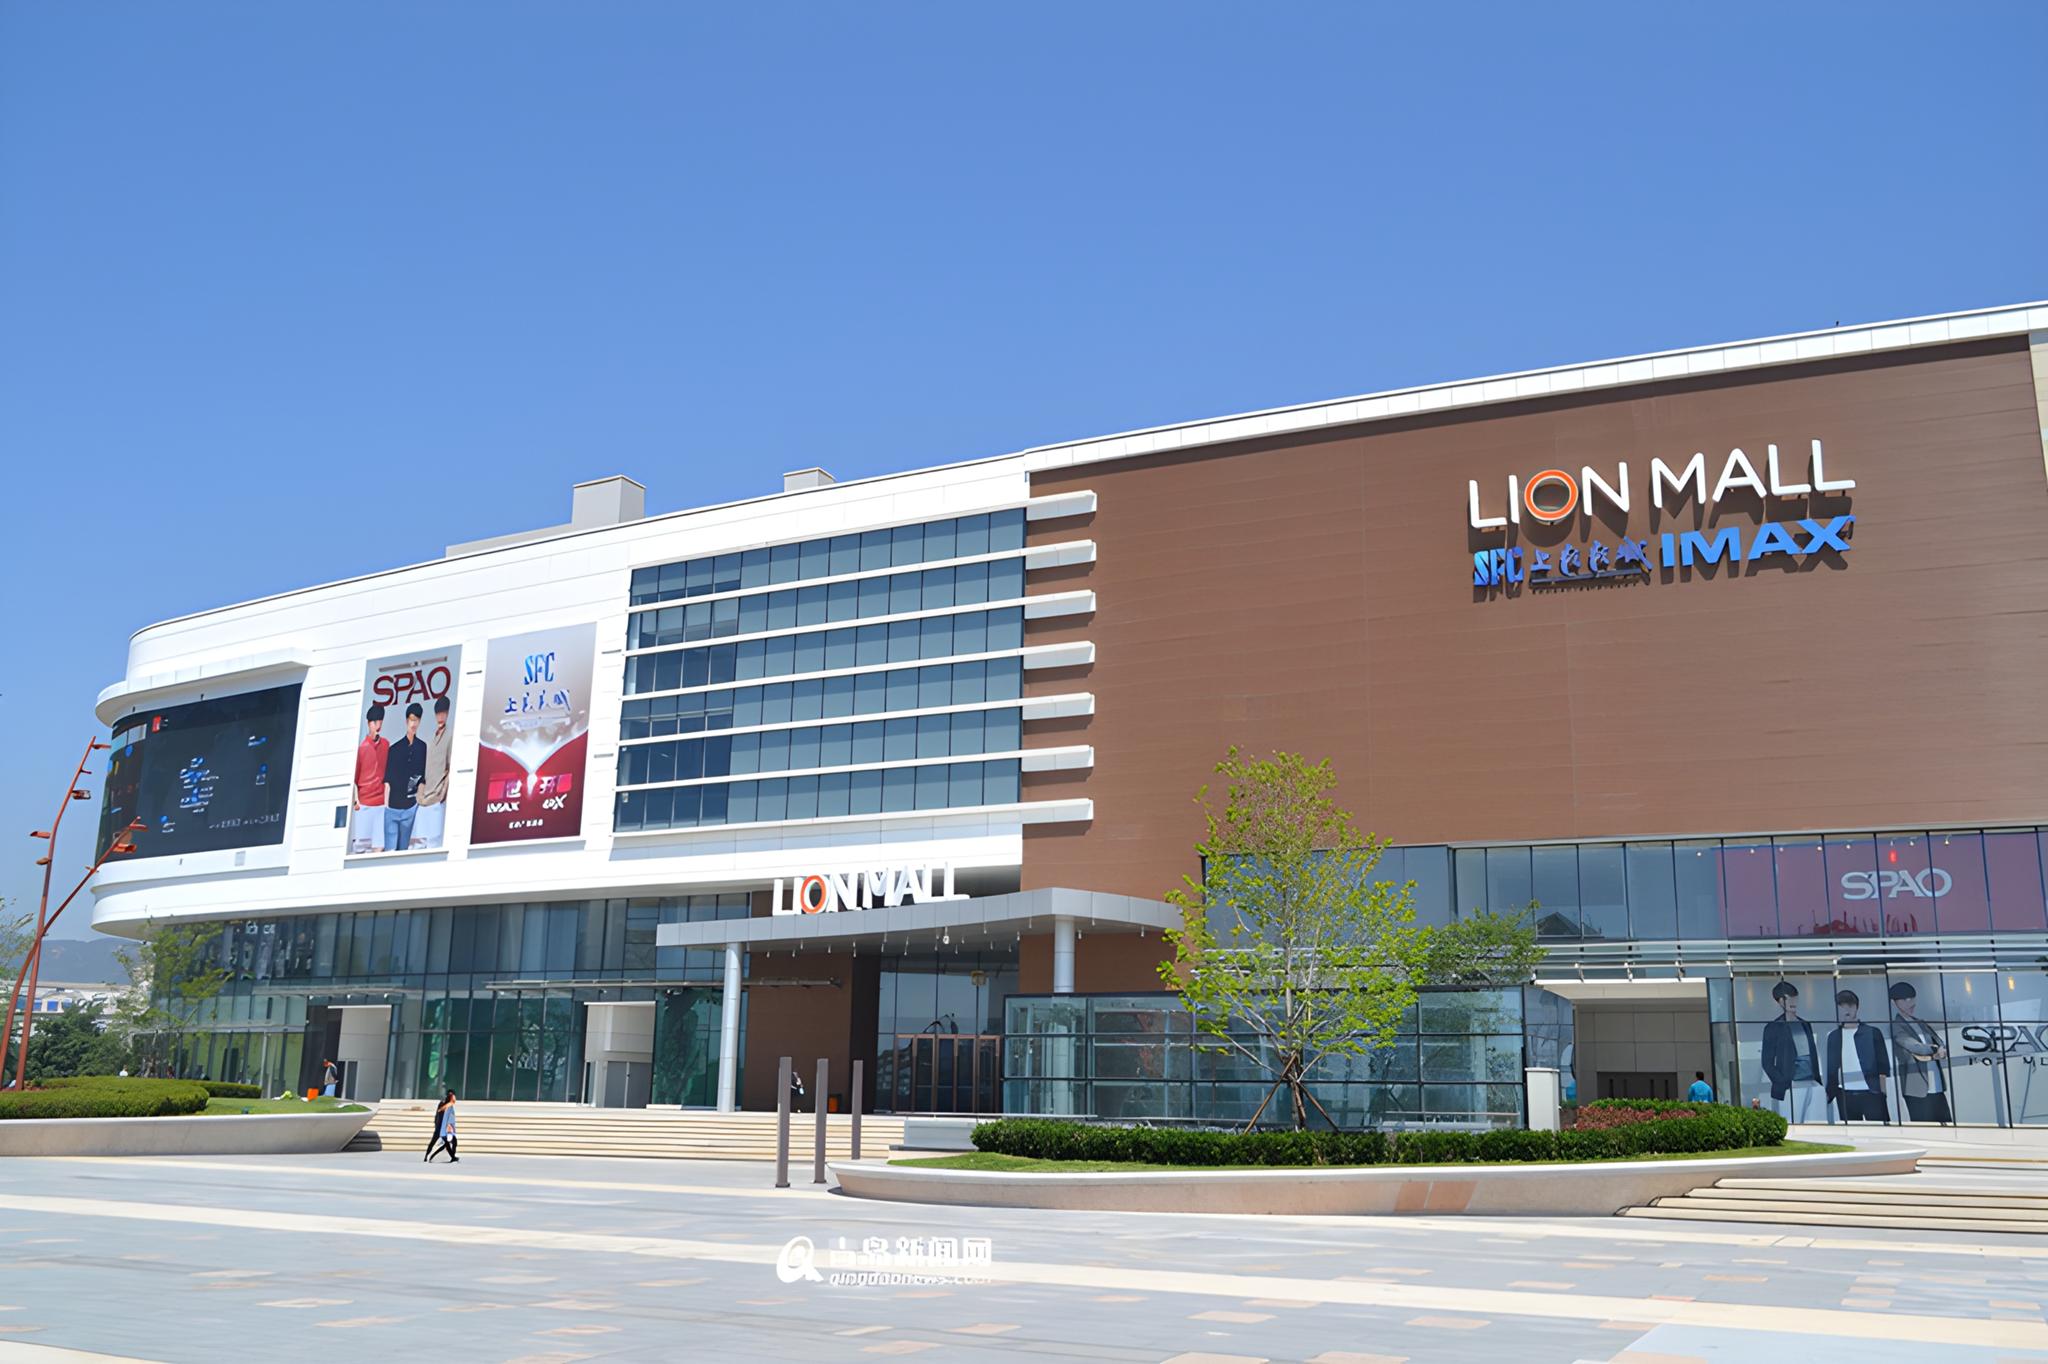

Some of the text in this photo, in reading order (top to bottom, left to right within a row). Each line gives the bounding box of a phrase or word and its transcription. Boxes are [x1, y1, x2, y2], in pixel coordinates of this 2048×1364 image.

[1469, 439, 1856, 529] LION MALL
[1661, 515, 1856, 567] IMAX
[1473, 547, 1524, 586] SFC
[372, 666, 452, 706] SPAO
[523, 652, 555, 685] SFC
[1840, 867, 1953, 901] SPAO
